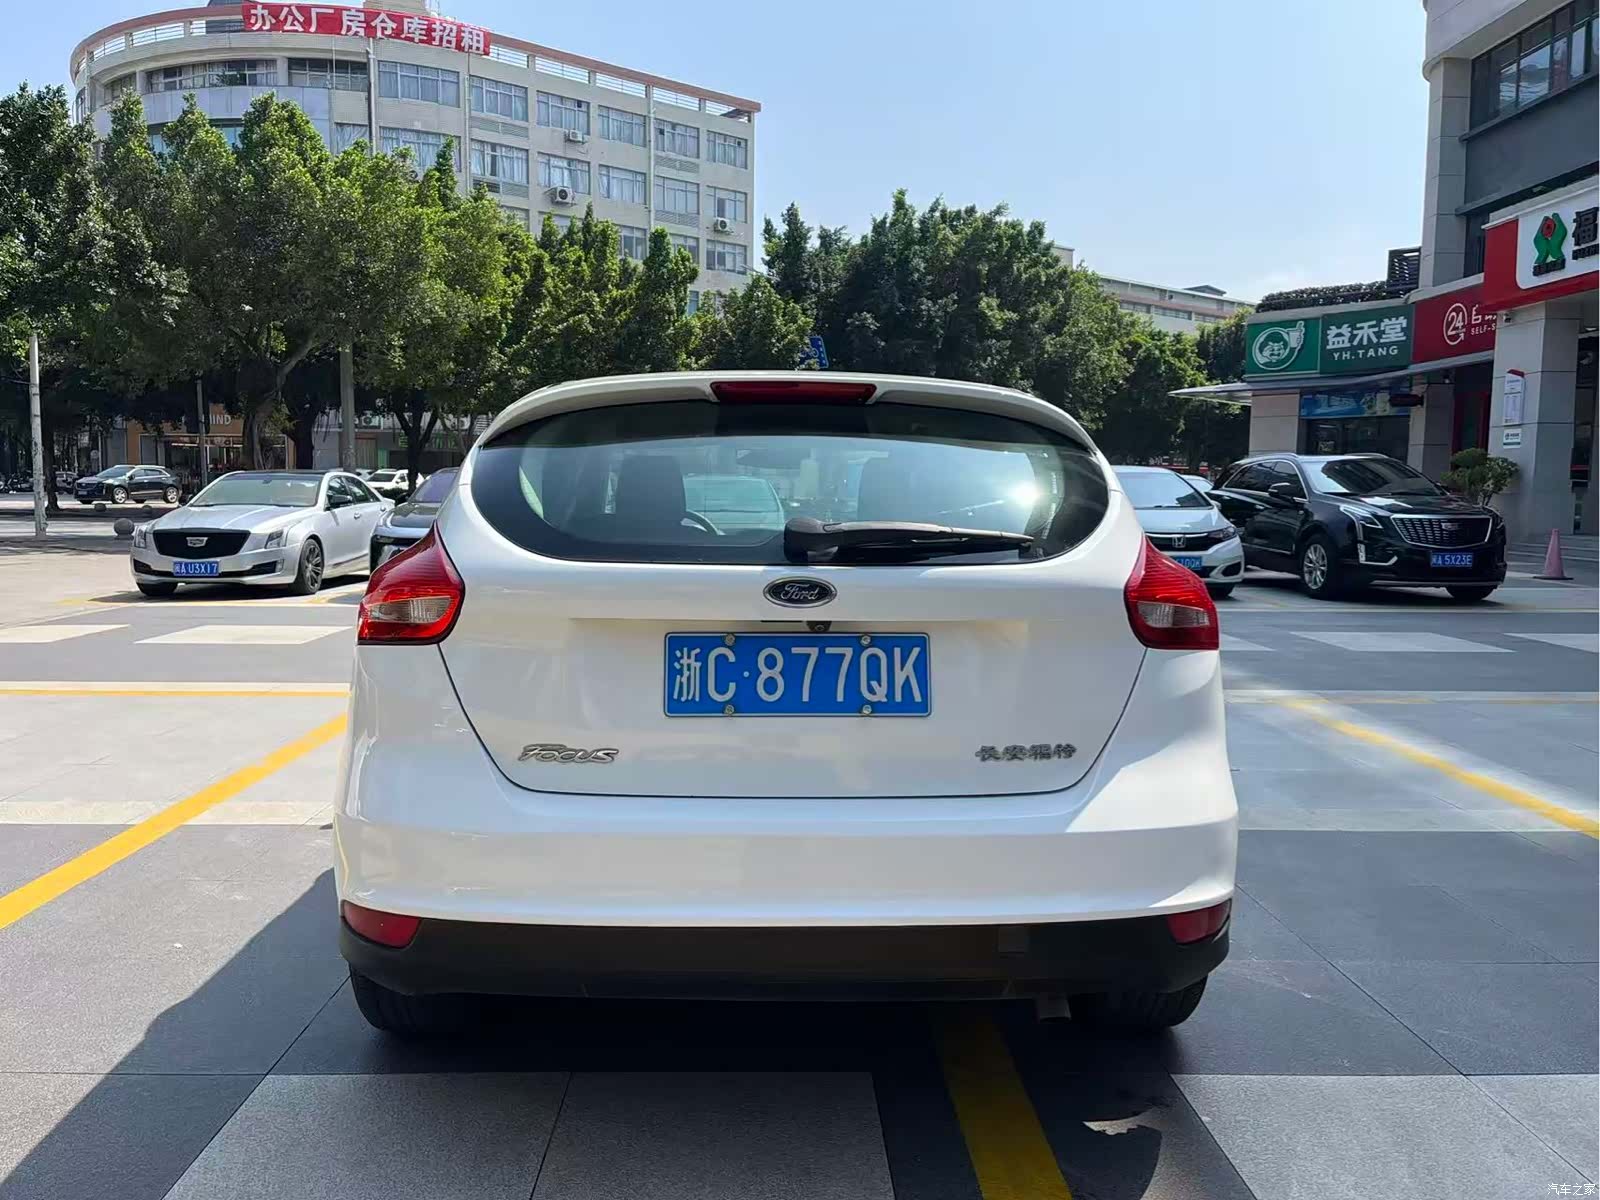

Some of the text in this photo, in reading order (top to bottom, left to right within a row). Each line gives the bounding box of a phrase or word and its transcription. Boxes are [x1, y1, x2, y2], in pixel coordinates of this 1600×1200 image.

[250, 5, 486, 55] 办公厂房仓库招租
[1326, 315, 1408, 350] 益禾堂
[1448, 311, 1465, 336] 24
[1332, 346, 1399, 361] YH.TANG
[781, 583, 820, 600] Ford
[673, 646, 922, 702] 浙C·877QK
[975, 743, 1077, 762] 长安福特
